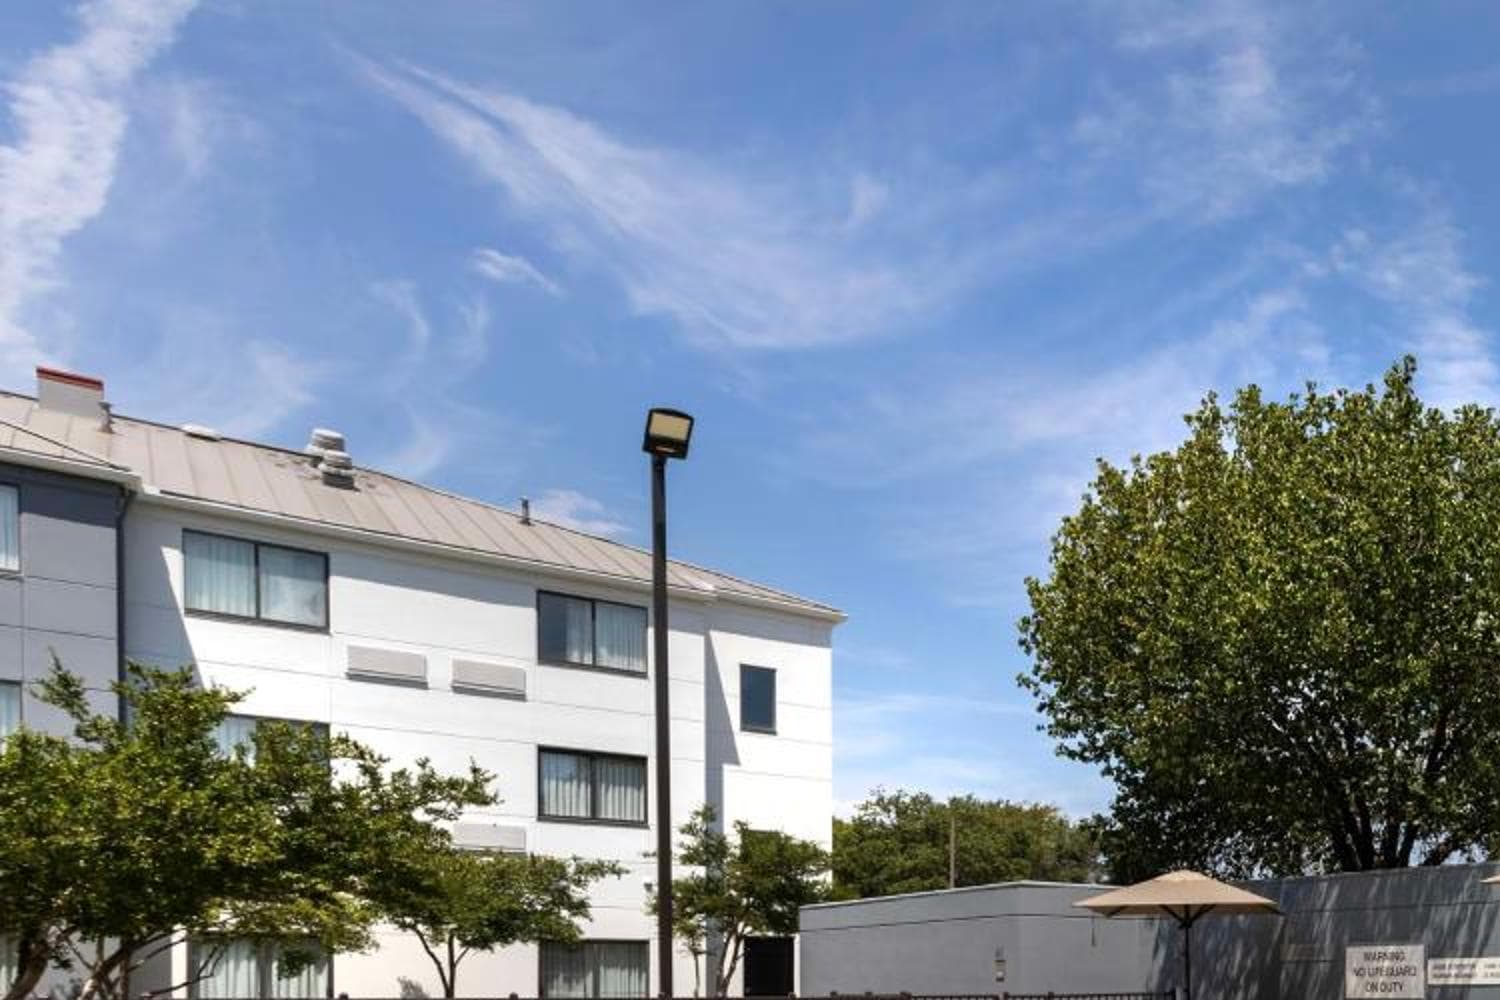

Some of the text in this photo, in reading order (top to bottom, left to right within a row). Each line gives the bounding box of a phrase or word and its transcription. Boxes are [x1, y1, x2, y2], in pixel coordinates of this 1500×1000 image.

[1363, 951, 1407, 962] WARNING
[1353, 967, 1366, 977] NO
[1365, 982, 1404, 993] ON DUTY
